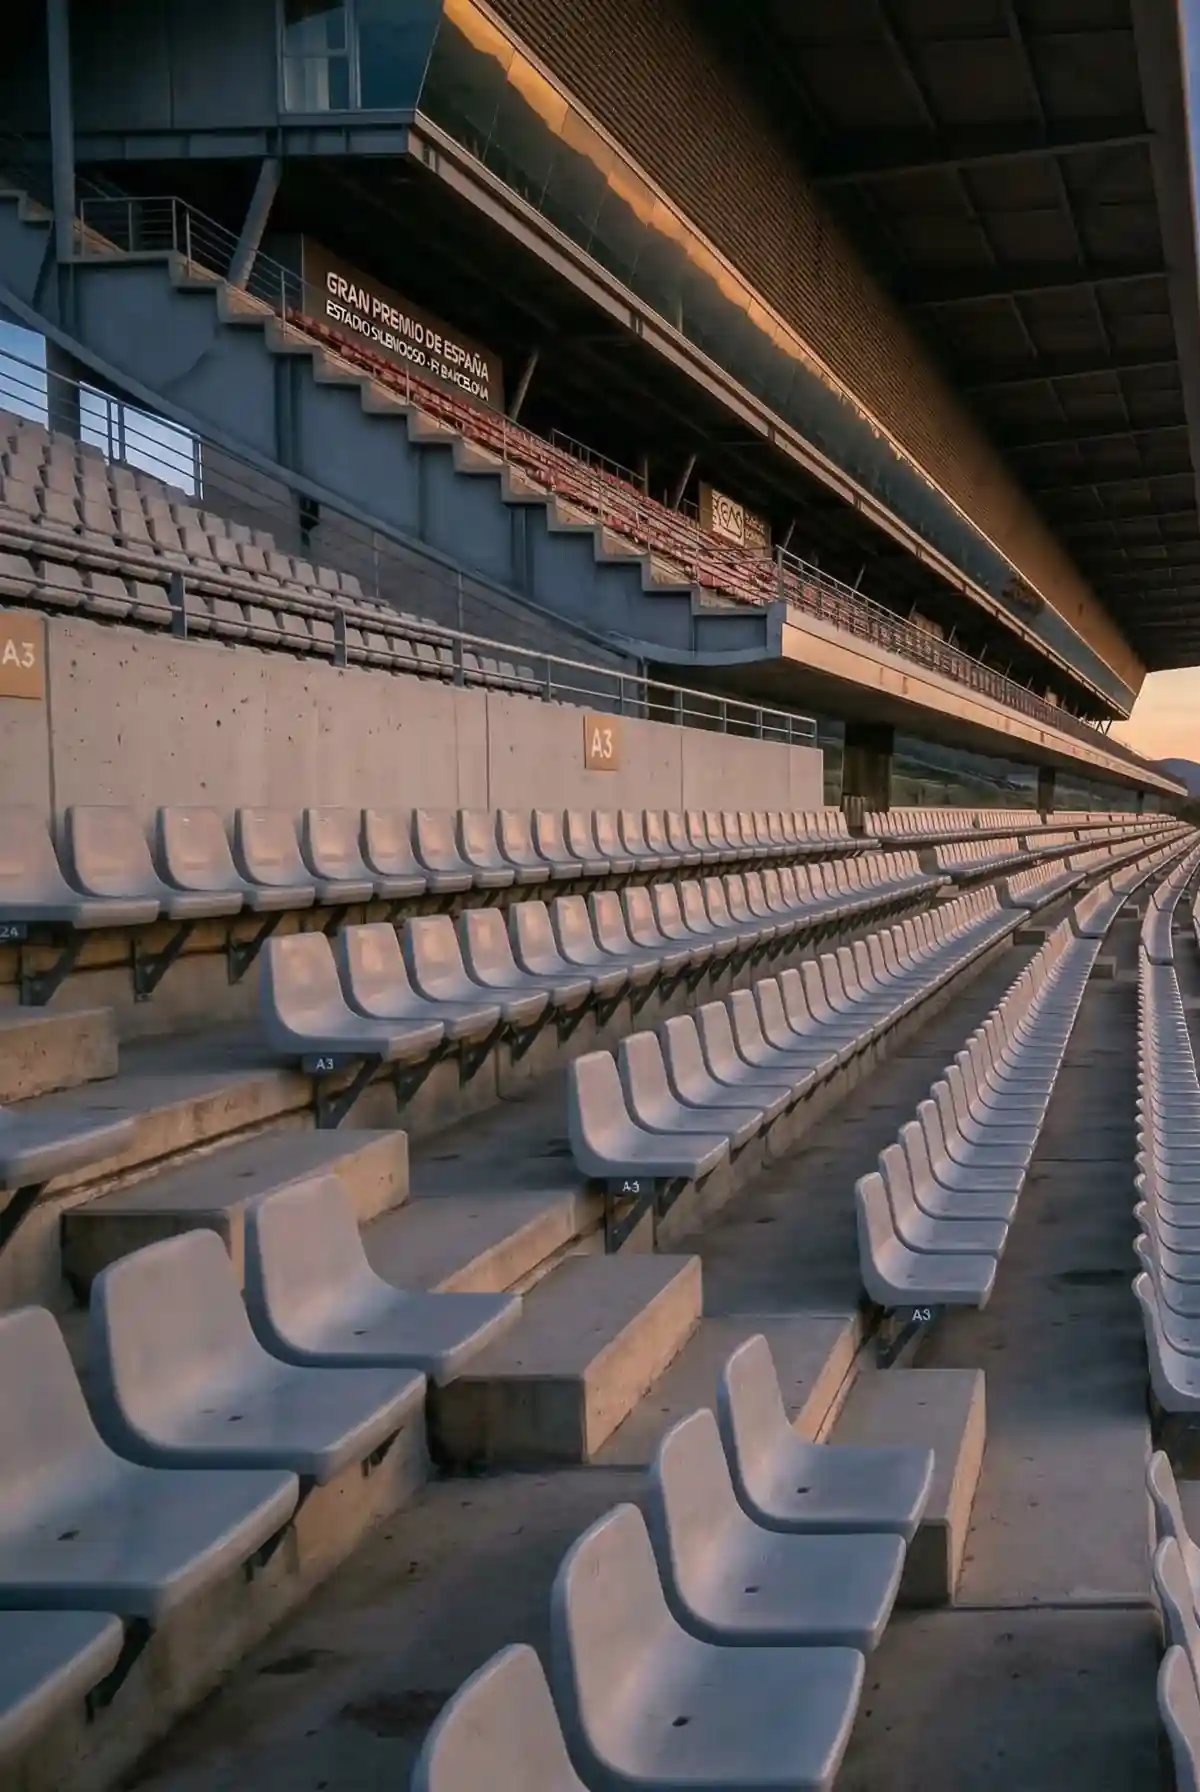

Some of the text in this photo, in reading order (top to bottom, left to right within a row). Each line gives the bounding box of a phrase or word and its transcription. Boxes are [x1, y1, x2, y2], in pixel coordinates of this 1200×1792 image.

[327, 300, 370, 337] ESTADIO
[327, 272, 489, 382] GRAN PREMIO DE ESPAÑA
[2, 639, 36, 668] A3
[591, 727, 612, 759] A3
[316, 1058, 334, 1070] A3
[622, 1180, 640, 1193] A3
[912, 1308, 931, 1321] A3
